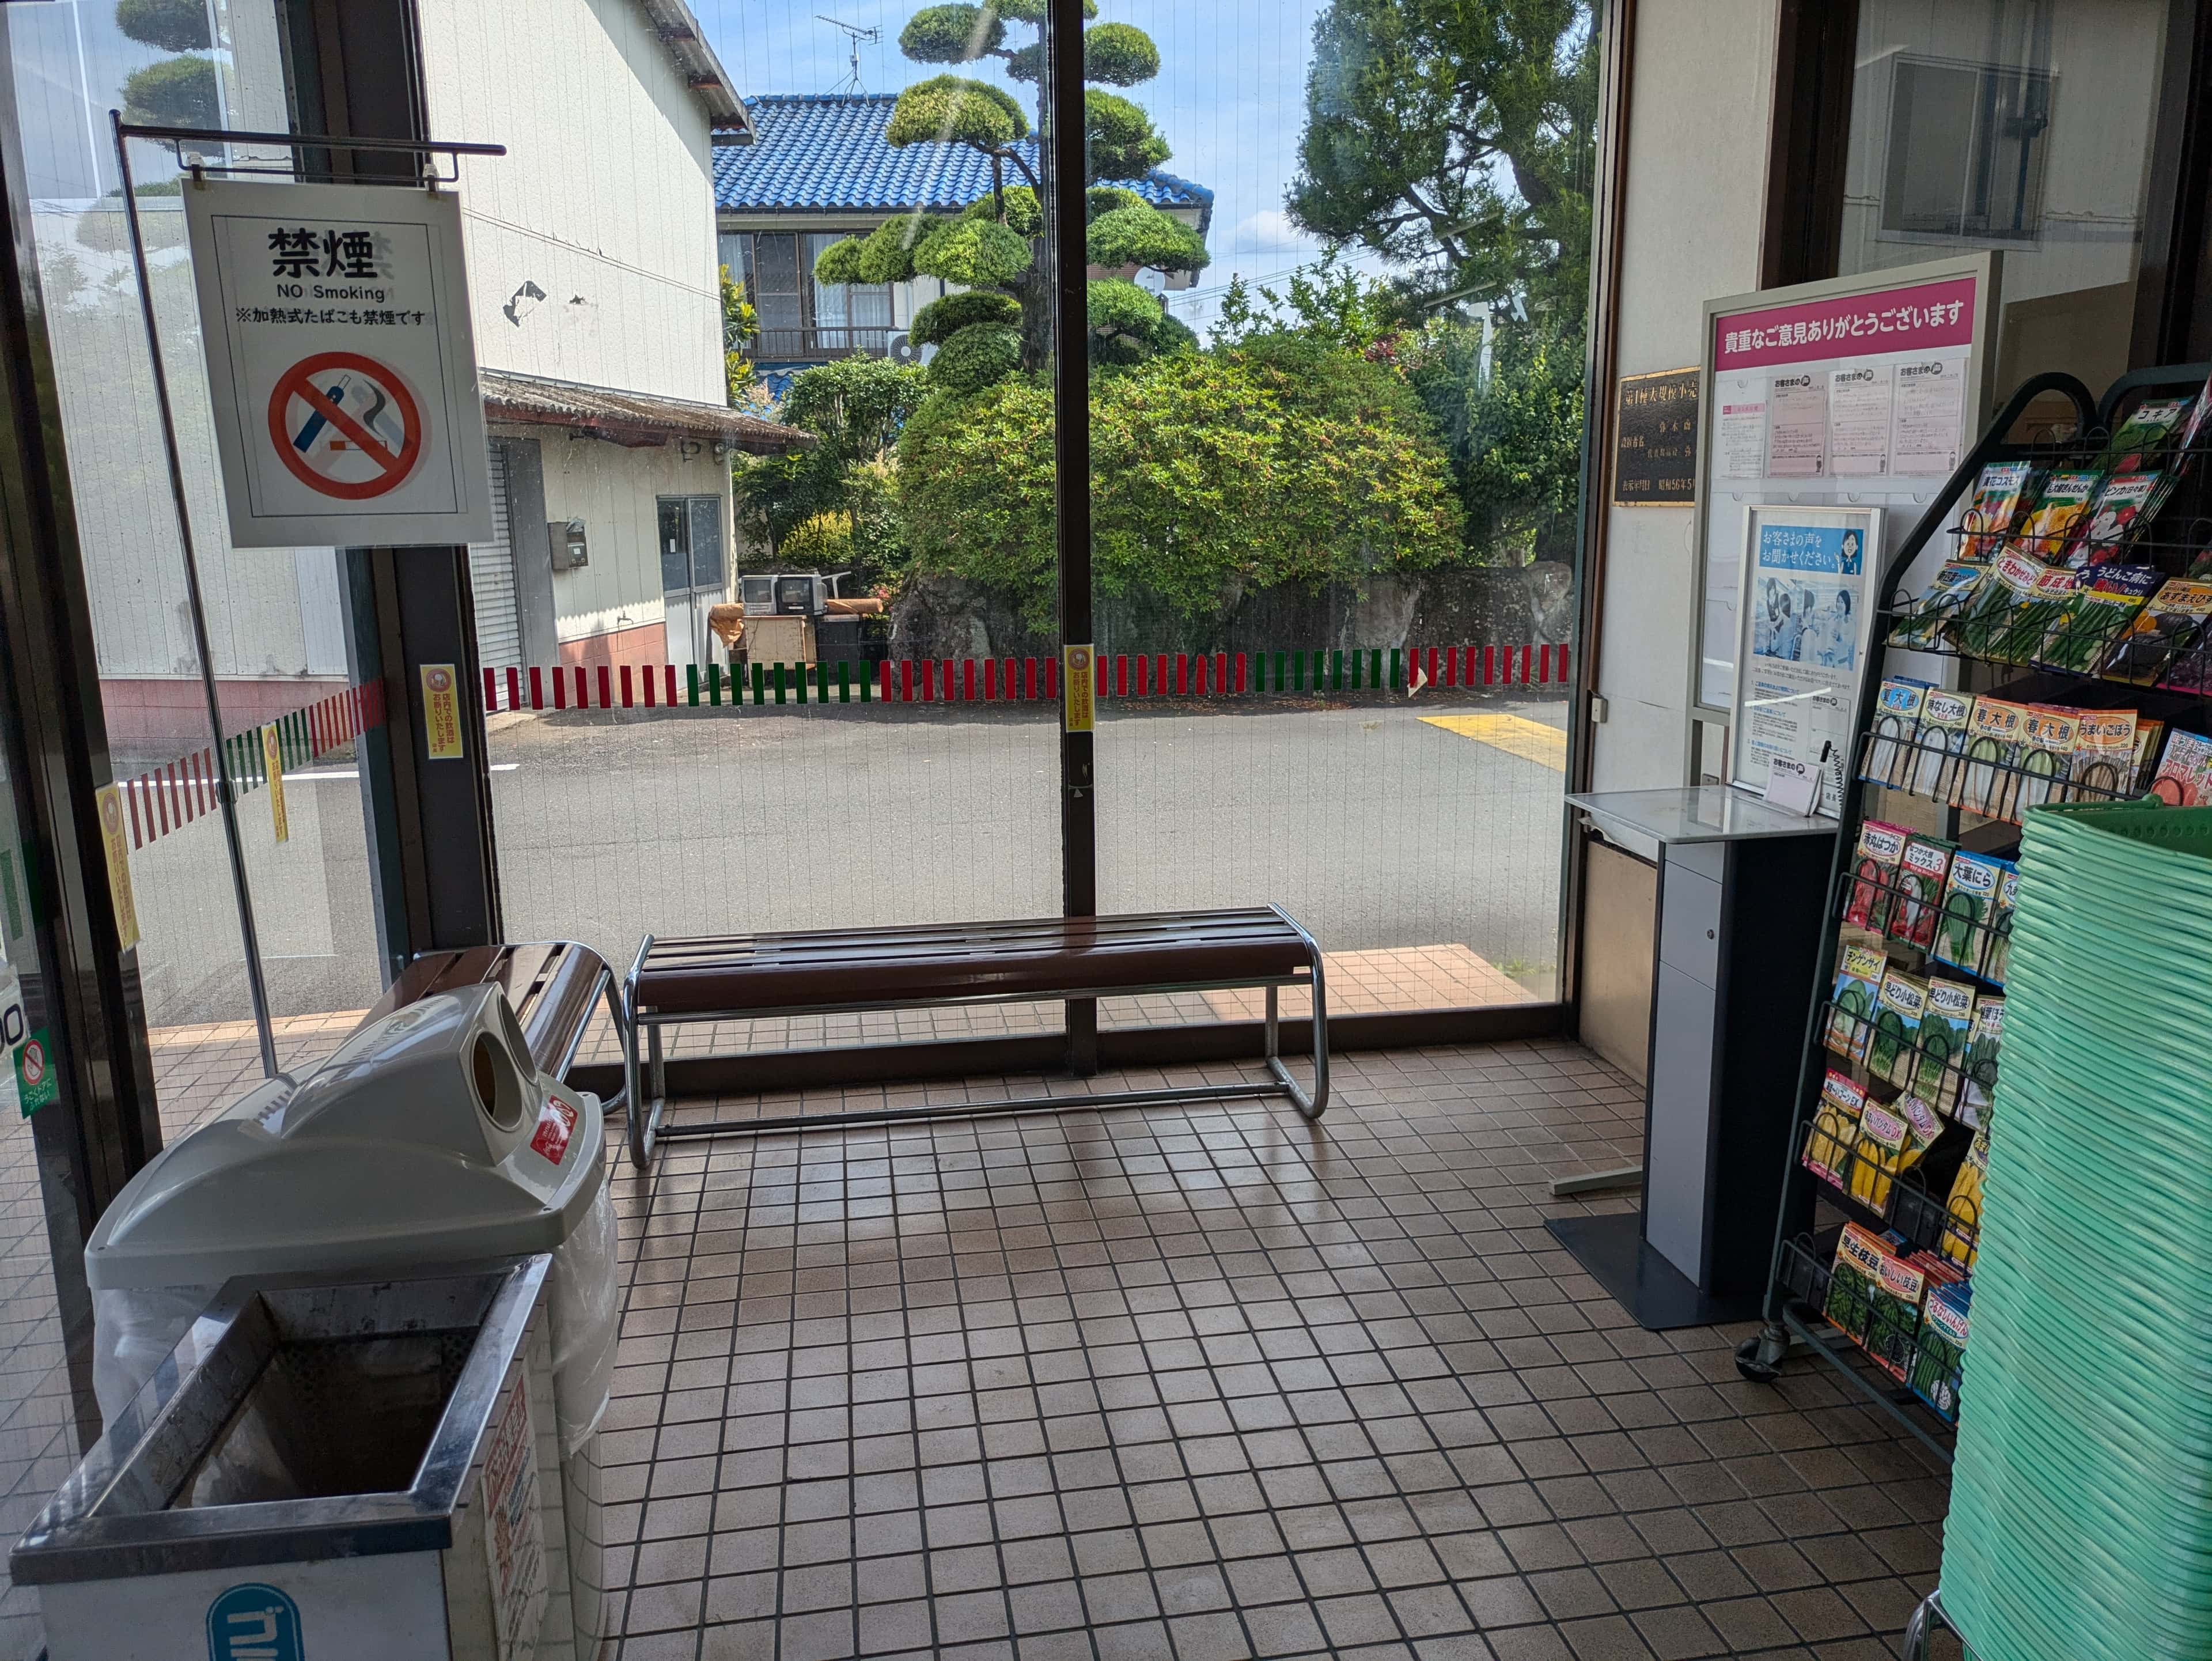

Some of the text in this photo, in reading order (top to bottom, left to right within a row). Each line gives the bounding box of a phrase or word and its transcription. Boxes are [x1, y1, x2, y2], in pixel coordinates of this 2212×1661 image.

[268, 228, 378, 279] 禁煙
[277, 284, 385, 302] NO Smoking
[236, 308, 425, 327] ※加熱式たばこも禁煙です
[1724, 300, 1964, 354] 貴重なご意見ありがとうございます
[2138, 408, 2177, 419] コキア
[1763, 531, 1822, 547] お客さまの声を
[1762, 548, 1835, 568] お聞かせください。
[2098, 566, 2152, 584] うどんこ病に
[1883, 688, 1916, 707] 夏大根
[1927, 699, 1966, 717] 時なし大根
[433, 694, 446, 752] お断りいたします
[442, 693, 454, 743] 店内での飲酒は
[1977, 708, 2016, 729] 春大根
[2028, 718, 2070, 740] 春大根
[2080, 724, 2130, 736] うまいごぼう
[1863, 831, 1899, 853] 赤丸はつか
[1908, 853, 1933, 869] ミックス
[1933, 858, 1944, 872] 3
[1953, 864, 1991, 887] 大葉にら
[1847, 951, 1881, 971] チンゲンサイ
[1884, 982, 1922, 1009] 早どり小松菜
[1929, 987, 1969, 1009] 早どり小松菜
[1842, 1235, 1880, 1272] 早生枝豆
[1880, 1264, 1919, 1293] おいしい枝豆
[1930, 1299, 1967, 1336] つるなしいんげん
